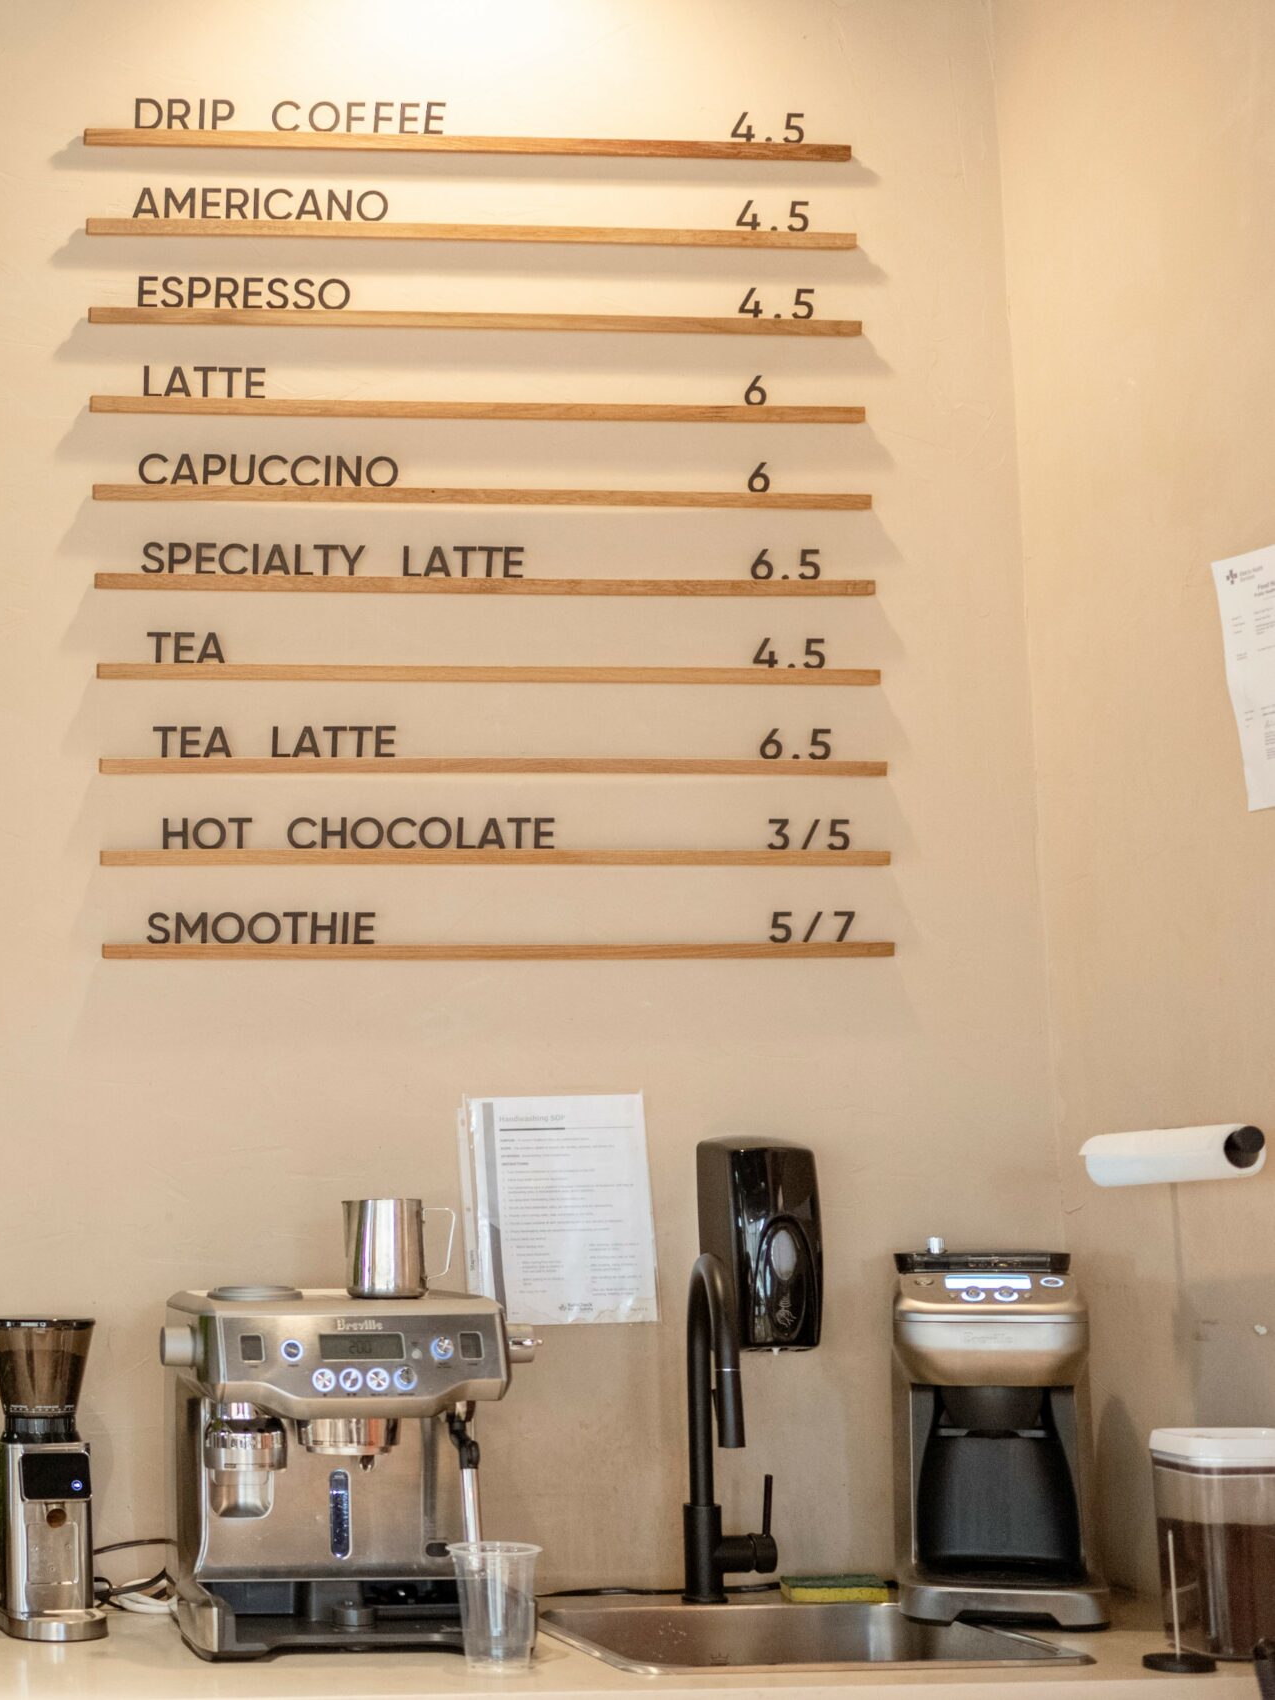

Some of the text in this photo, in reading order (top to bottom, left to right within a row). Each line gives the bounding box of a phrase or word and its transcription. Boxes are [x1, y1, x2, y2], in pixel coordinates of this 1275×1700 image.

[134, 98, 804, 144] DRIP COFFEE 4.5
[133, 187, 810, 233] AMERICANO 4.5
[137, 276, 815, 320] ESPRESSO 4.5
[142, 366, 767, 406] LATTE 6
[138, 453, 771, 493] CAPUCCINO 6
[140, 542, 822, 580] SPECIALTY LATTE 6.5
[146, 631, 827, 668] TEA 4.5
[153, 725, 832, 760] TEA LATTE 6.5
[162, 816, 852, 850] HOT CHOCOLATE 3/5
[145, 910, 857, 944] SMOOTHIE 5/7
[336, 1319, 383, 1331] Breville
